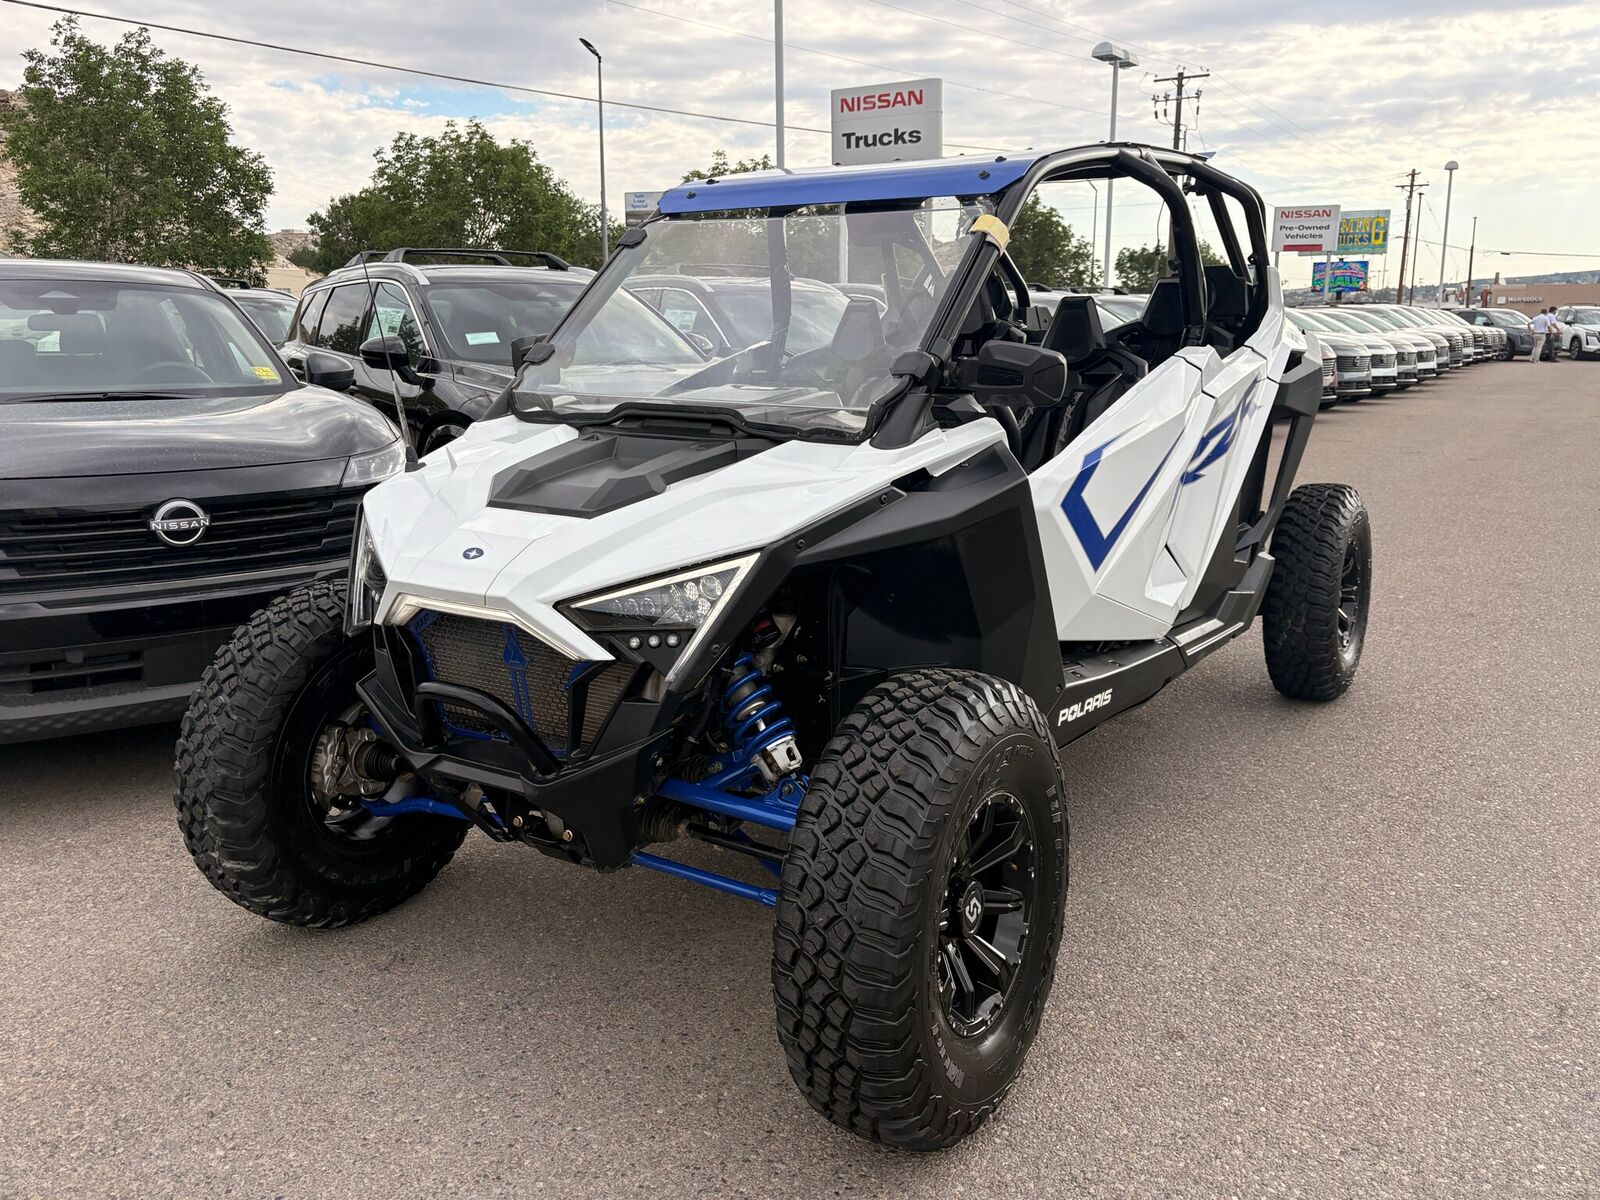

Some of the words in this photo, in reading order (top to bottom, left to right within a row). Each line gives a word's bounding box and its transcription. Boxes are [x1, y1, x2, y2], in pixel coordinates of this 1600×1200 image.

[840, 89, 923, 113] NISSAN
[841, 128, 922, 149] Trucks
[1280, 209, 1332, 219] NISSAN
[151, 518, 209, 530] NISSAN
[1057, 688, 1113, 727] POLARIS
